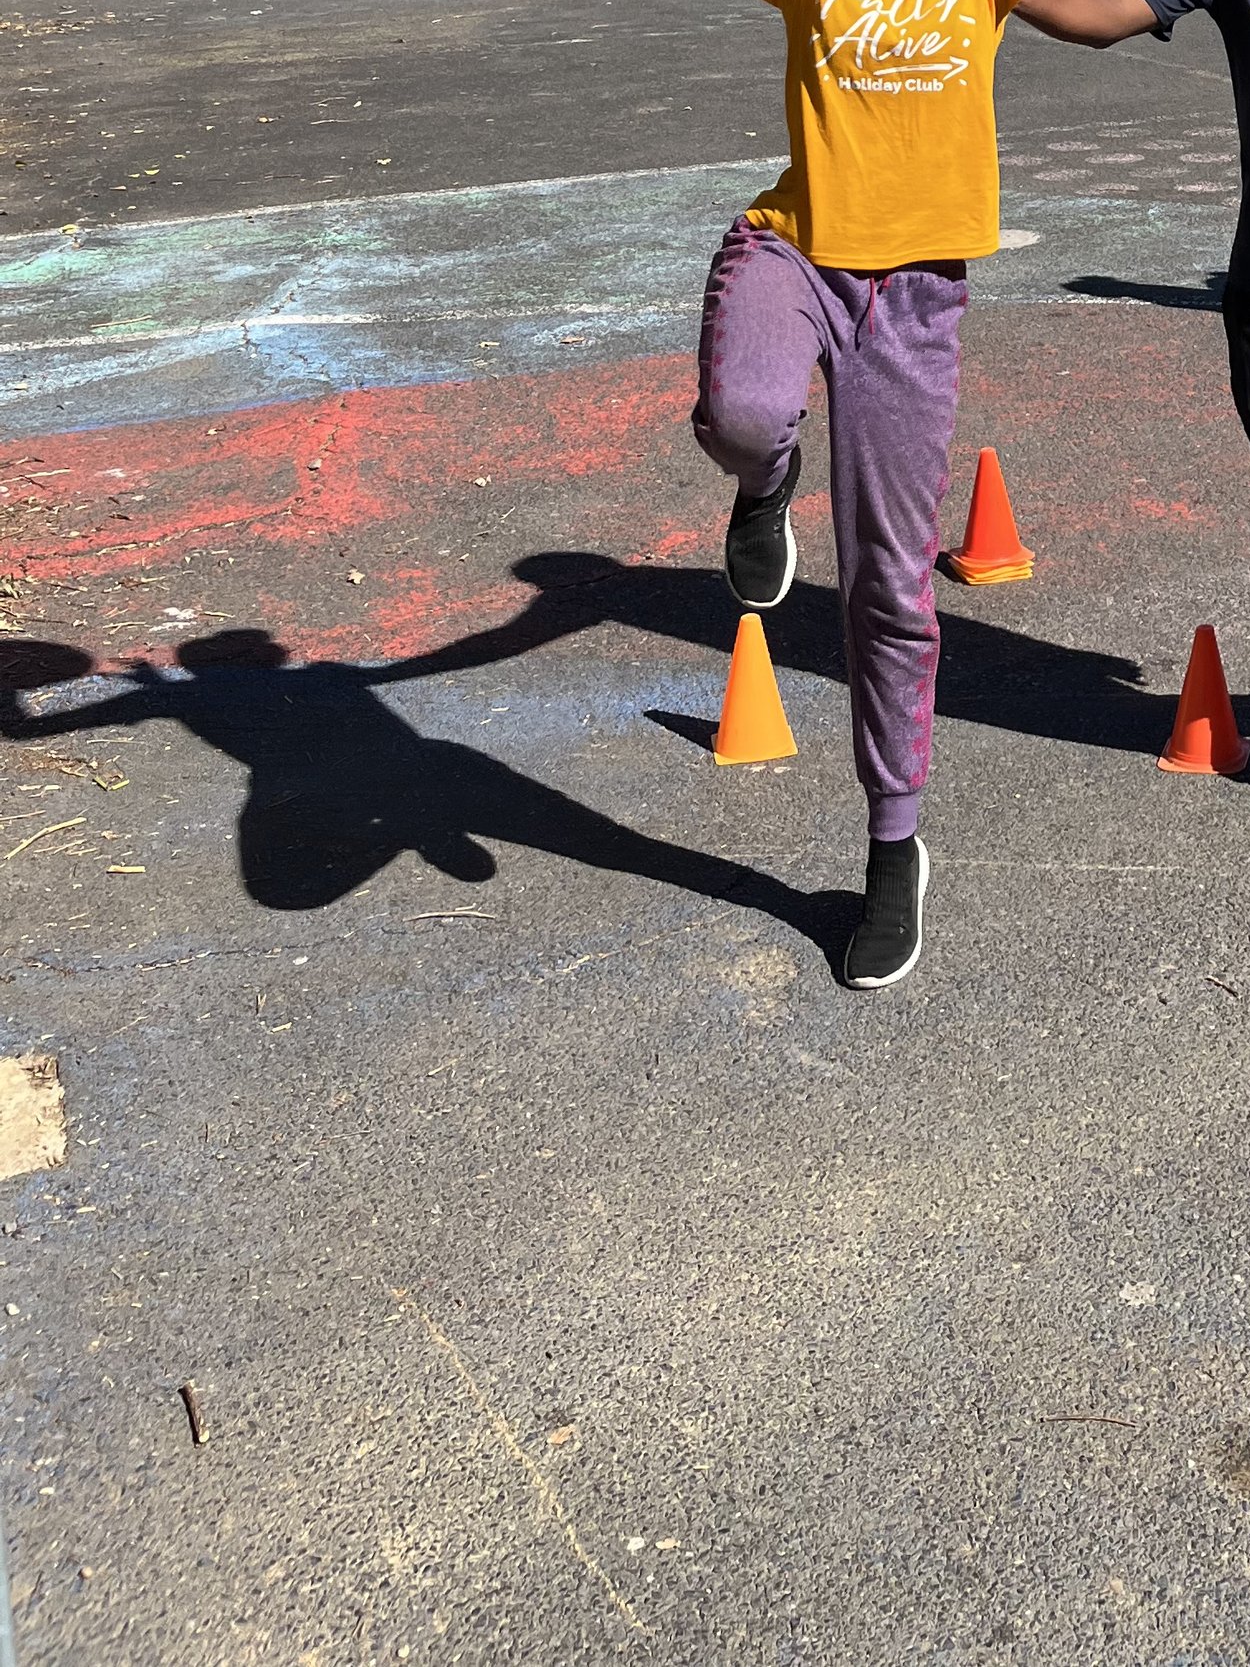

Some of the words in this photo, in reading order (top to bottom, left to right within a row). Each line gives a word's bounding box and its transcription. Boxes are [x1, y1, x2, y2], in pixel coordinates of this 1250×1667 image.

[816, 9, 952, 70] Alive
[838, 76, 902, 94] Holiday
[904, 78, 945, 92] Club
